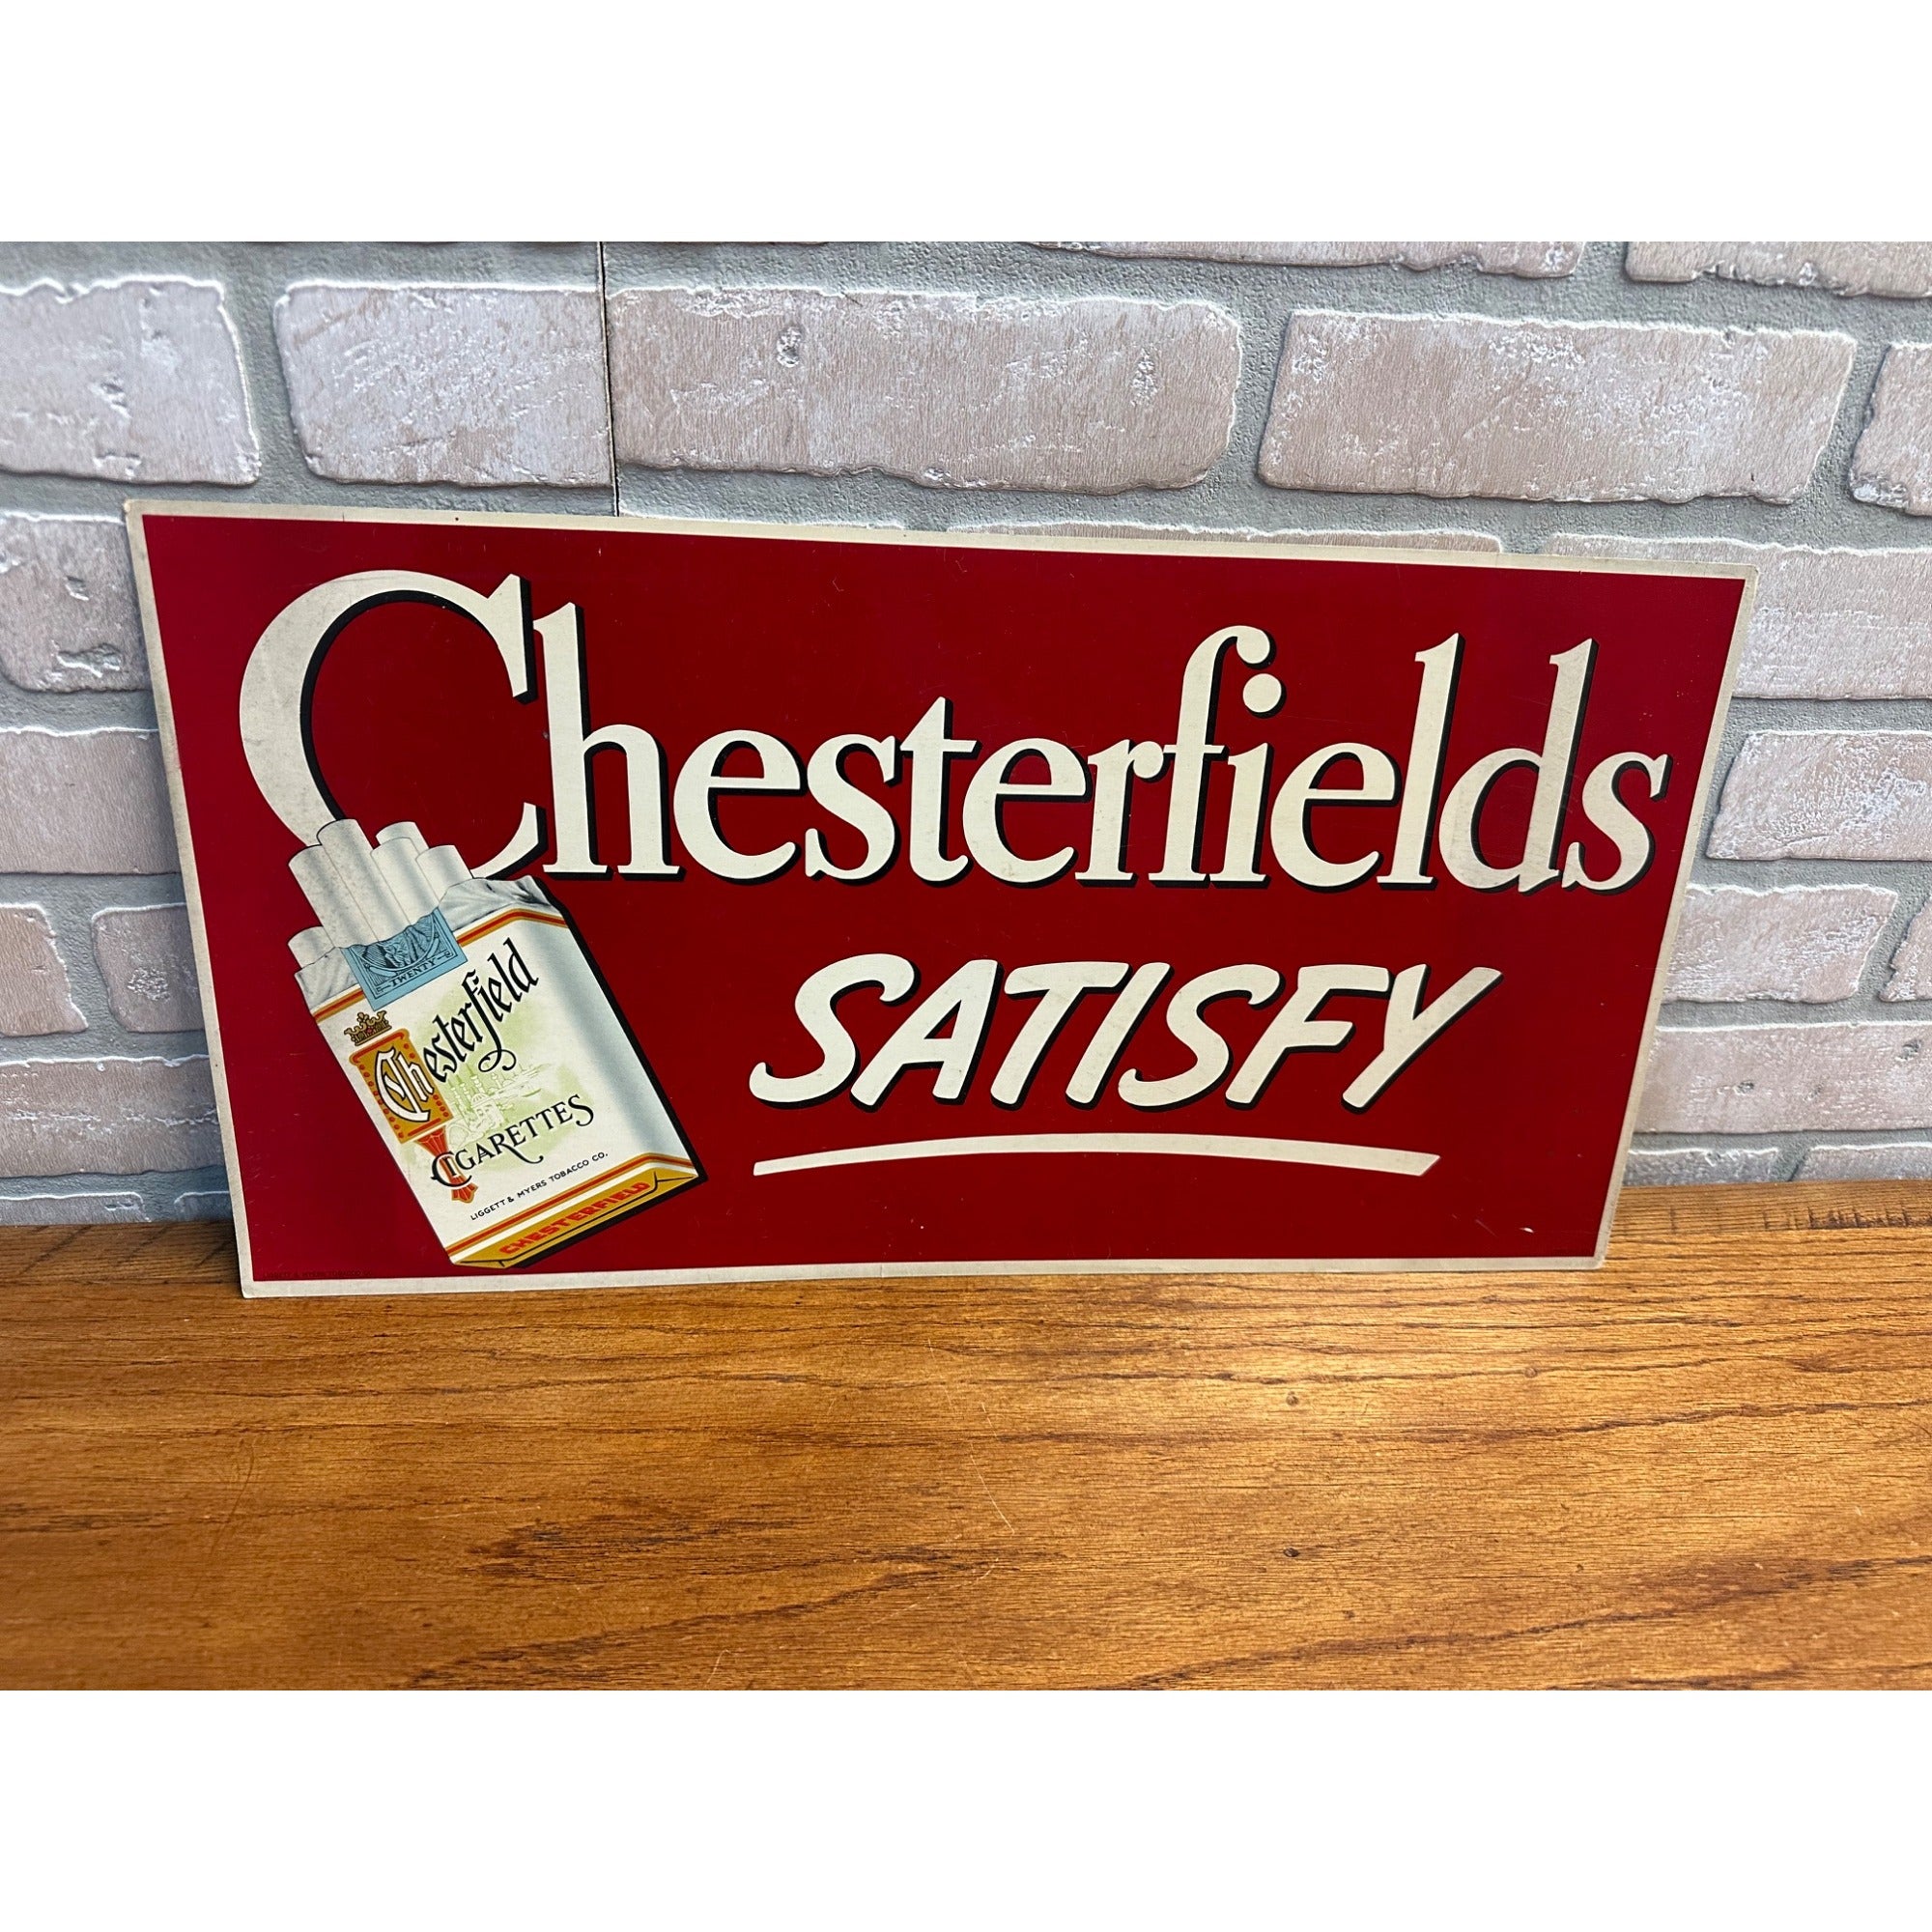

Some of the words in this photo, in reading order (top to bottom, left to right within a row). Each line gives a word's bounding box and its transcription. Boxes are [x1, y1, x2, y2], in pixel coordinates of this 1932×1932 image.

[239, 568, 1671, 895] Chesterfields
[388, 957, 437, 986] TWENTY
[374, 937, 539, 1122] Chesterfield
[749, 953, 1503, 1111] SATISFY
[430, 1094, 594, 1187] CIGARETTES
[470, 1199, 506, 1221] LIGGETT
[517, 1179, 548, 1199] MYERS
[548, 1159, 589, 1182] TOBACCO
[591, 1151, 609, 1162] CO.
[498, 1180, 651, 1255] CHESTERFIELD
